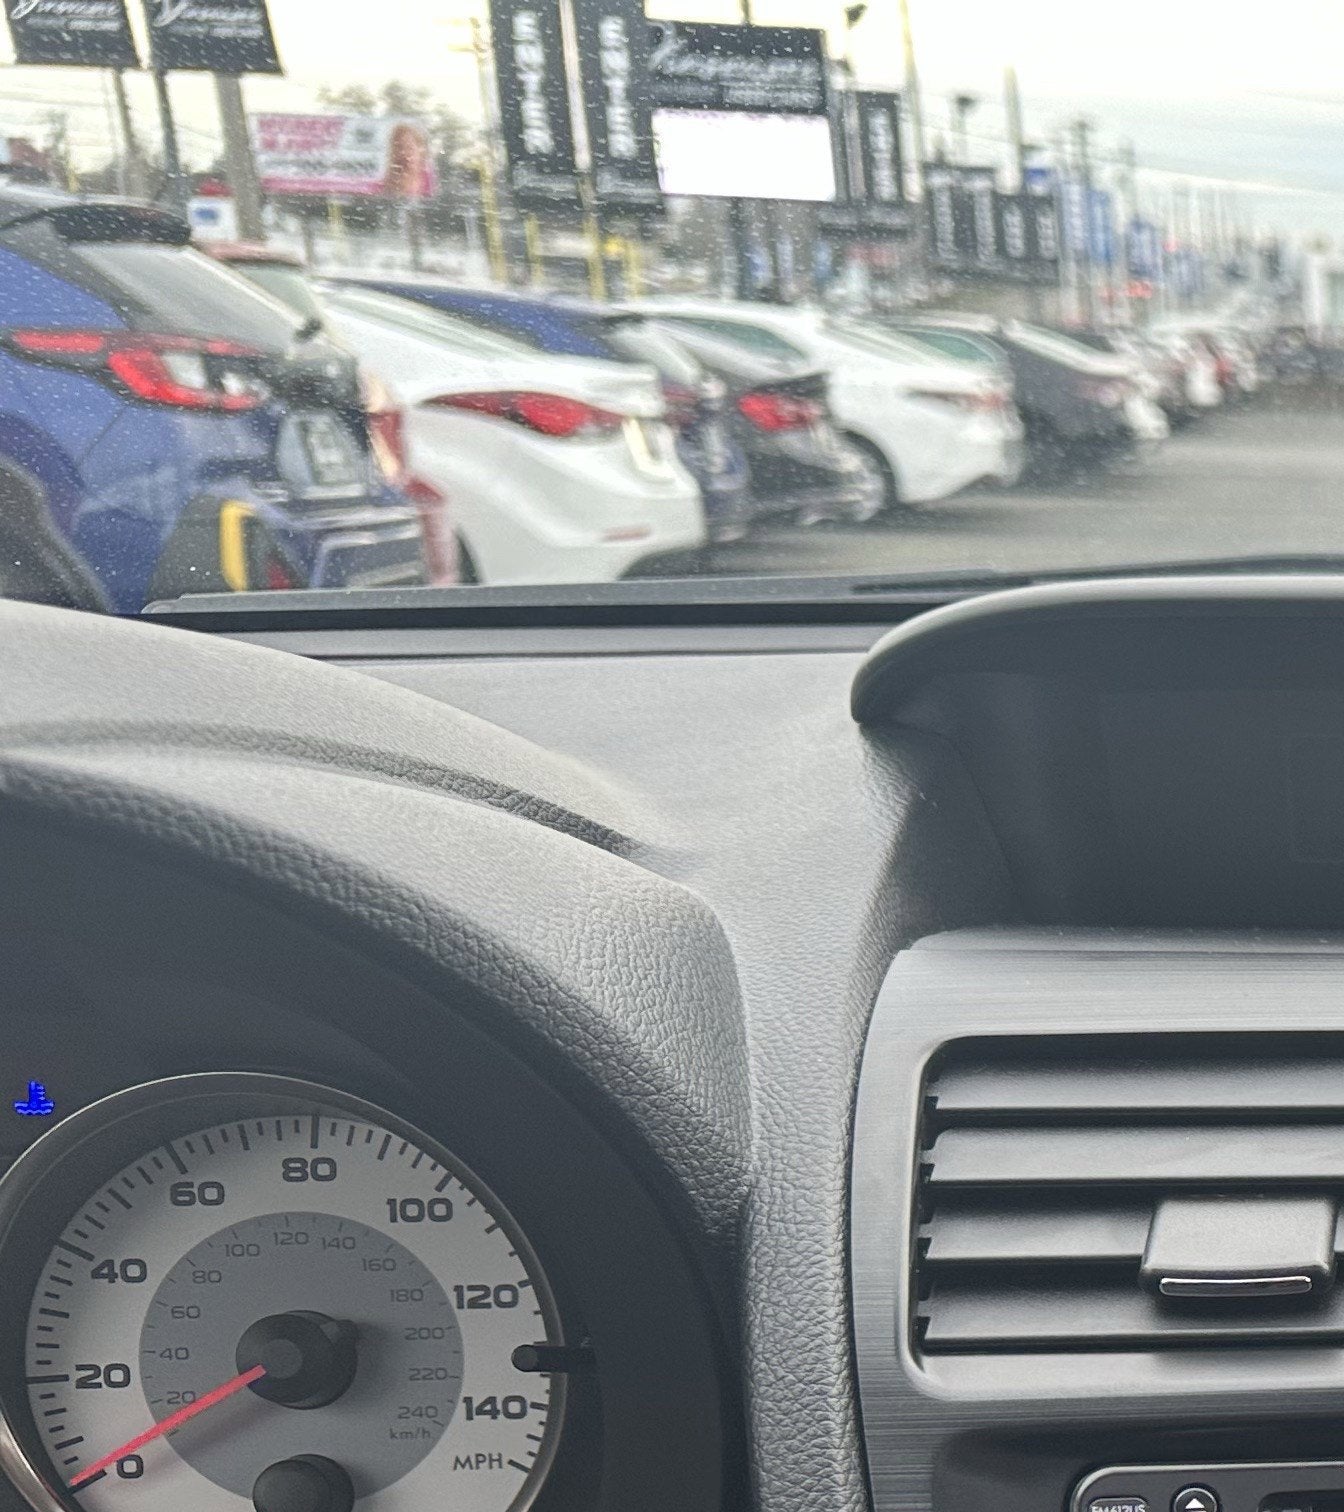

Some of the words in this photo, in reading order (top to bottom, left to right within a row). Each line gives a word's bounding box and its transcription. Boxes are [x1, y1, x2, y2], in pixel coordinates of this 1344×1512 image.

[282, 1157, 337, 1182] 80
[170, 1181, 226, 1207] 60
[387, 1197, 454, 1223] 100
[273, 1231, 309, 1246] 120
[322, 1236, 356, 1250] 140
[225, 1243, 261, 1258] 100
[91, 1258, 148, 1284] 40
[362, 1258, 396, 1272] 160
[192, 1270, 222, 1284] 80
[390, 1288, 424, 1302] 180
[454, 1284, 519, 1309] 120
[171, 1305, 201, 1319] 60
[404, 1327, 445, 1340] 200
[160, 1347, 189, 1361] 40
[75, 1363, 131, 1389] 20
[408, 1367, 448, 1381] 220
[167, 1390, 196, 1404] 20
[397, 1405, 438, 1420] 240
[463, 1395, 528, 1421] 140
[389, 1428, 431, 1440] km/h
[116, 1455, 144, 1479] 0
[453, 1452, 503, 1471] MPH
